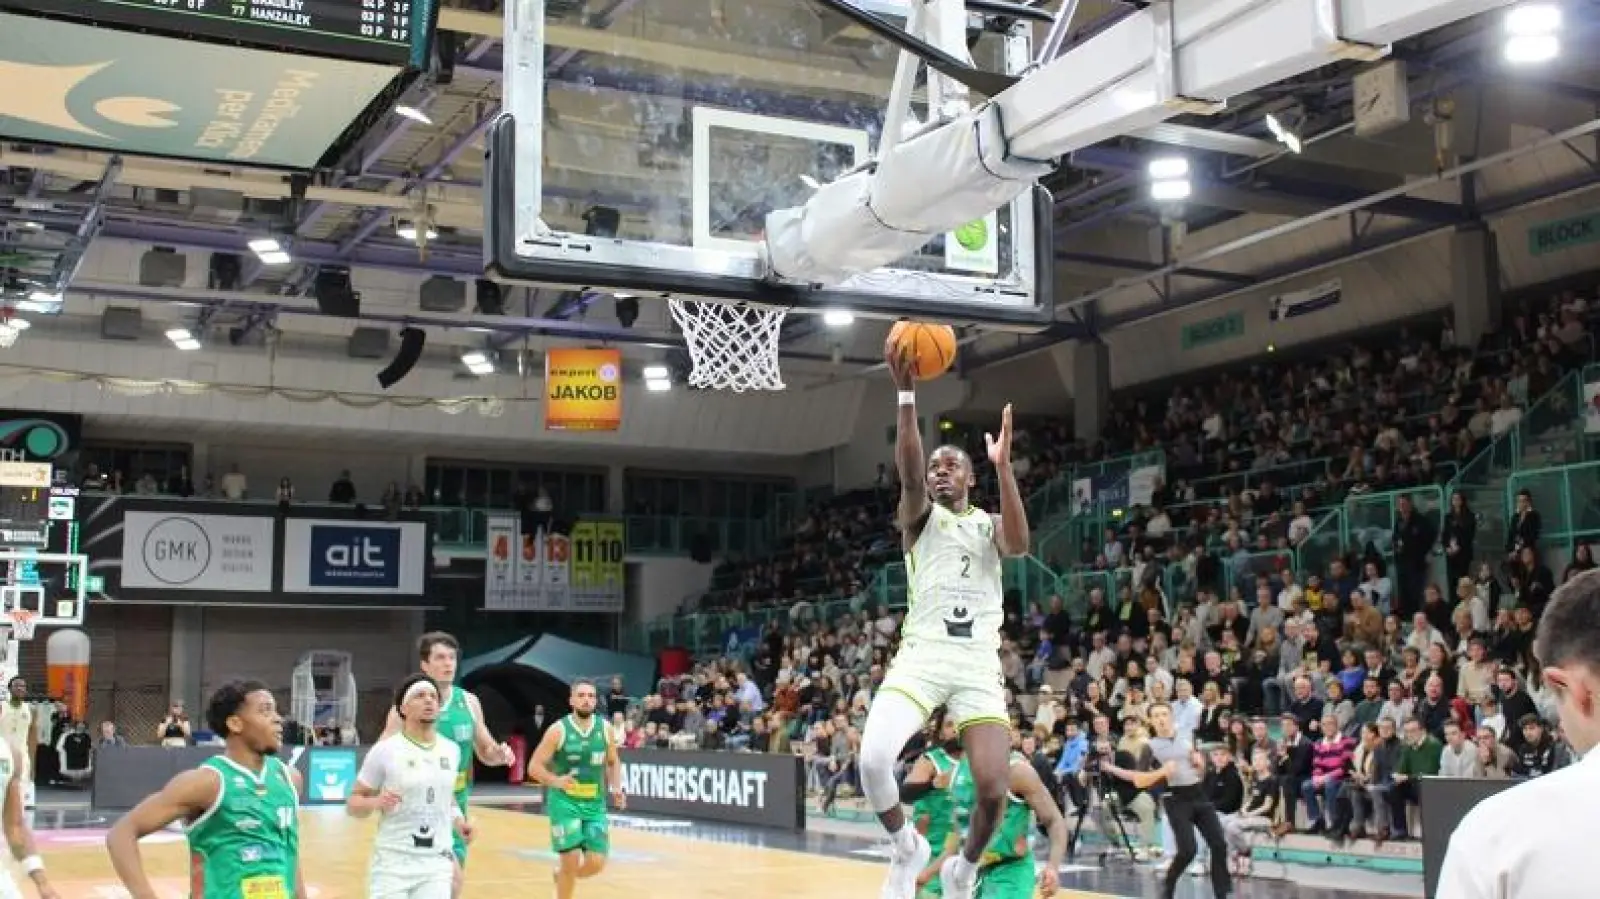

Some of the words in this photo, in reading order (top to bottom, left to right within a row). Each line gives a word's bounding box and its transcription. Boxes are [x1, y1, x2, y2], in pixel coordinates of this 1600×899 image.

[232, 4, 246, 16] 77
[551, 385, 616, 401] JAKOB
[154, 540, 198, 562] GMK
[325, 536, 385, 567] ait
[576, 539, 593, 562] 11
[600, 539, 621, 563] 10
[961, 555, 971, 578] 2
[610, 762, 768, 809] ARTNERSCHAFT
